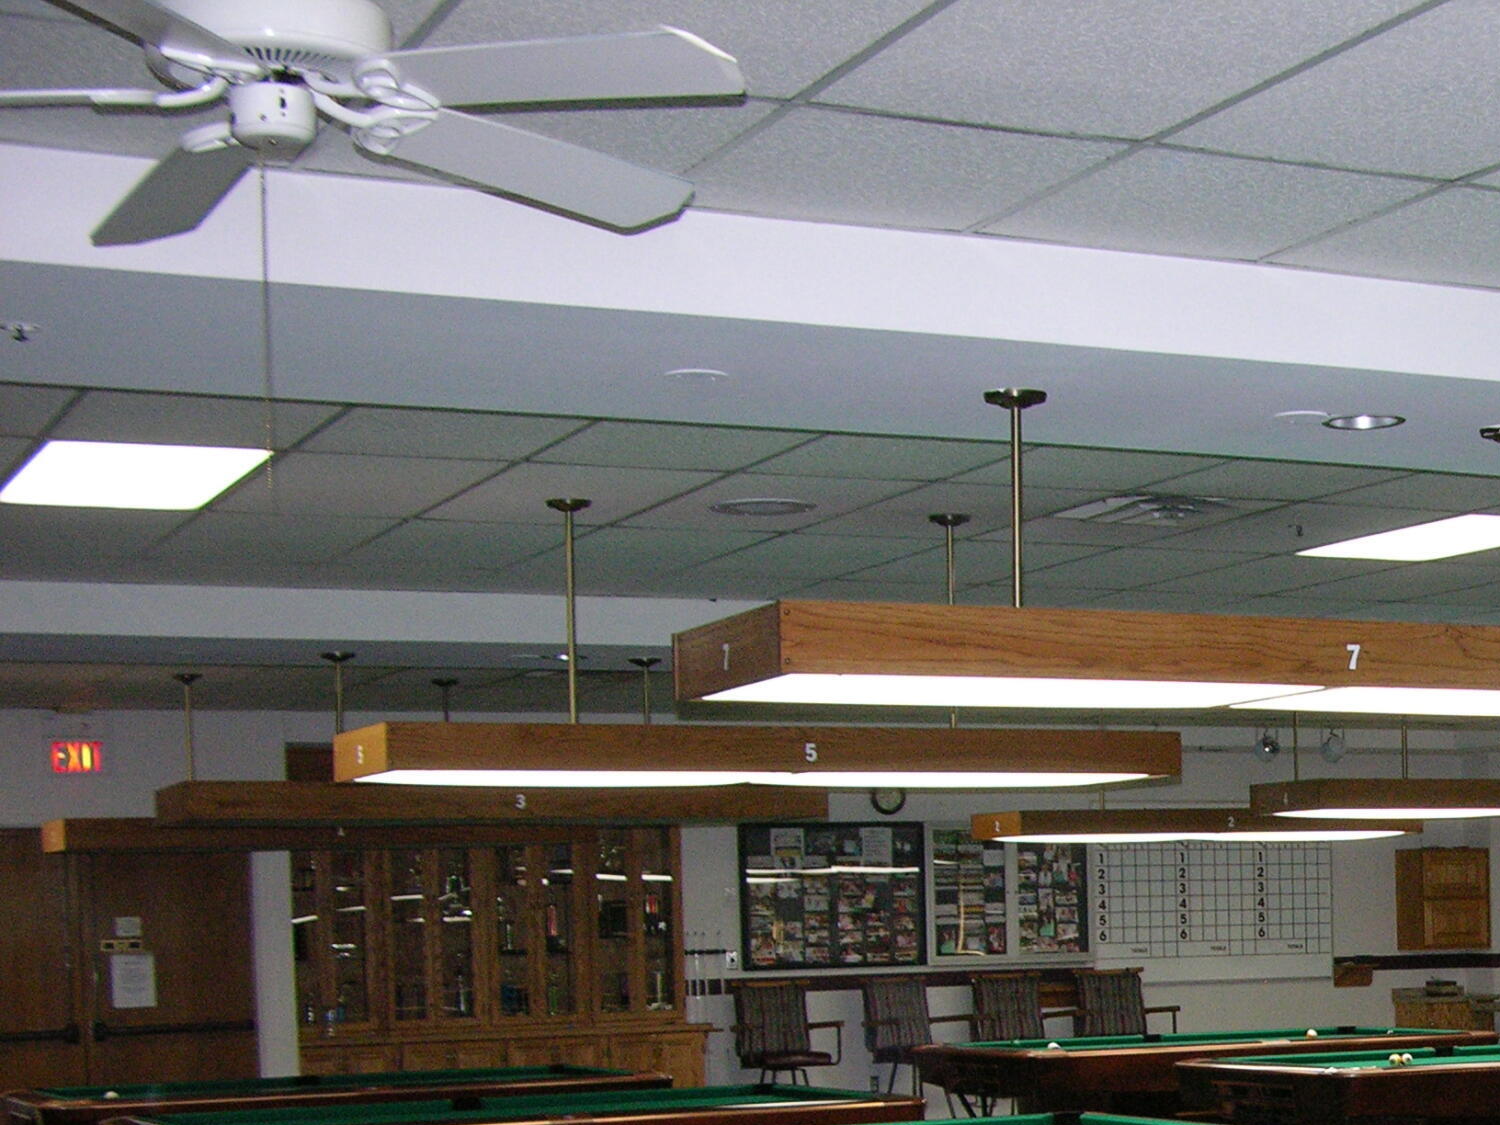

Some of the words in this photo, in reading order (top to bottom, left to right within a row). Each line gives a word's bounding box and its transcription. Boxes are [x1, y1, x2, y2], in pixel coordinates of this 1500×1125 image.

[1346, 644, 1361, 670] 7
[51, 741, 103, 773] EXIT
[805, 743, 818, 762] 5
[515, 794, 527, 809] 3
[1098, 868, 1105, 879] 2
[1179, 867, 1186, 879] 2
[1257, 867, 1264, 878] 2
[1098, 884, 1105, 895] 3
[1179, 883, 1186, 894] 3
[1258, 882, 1264, 893] 3
[1098, 899, 1106, 910] 4
[1179, 898, 1187, 909] 4
[1257, 897, 1265, 908] 4
[1099, 915, 1106, 926] 5
[1180, 914, 1187, 925] 5
[1258, 912, 1265, 923] 5
[1099, 930, 1107, 942] 6
[1180, 929, 1187, 940] 6
[1258, 927, 1265, 938] 6
